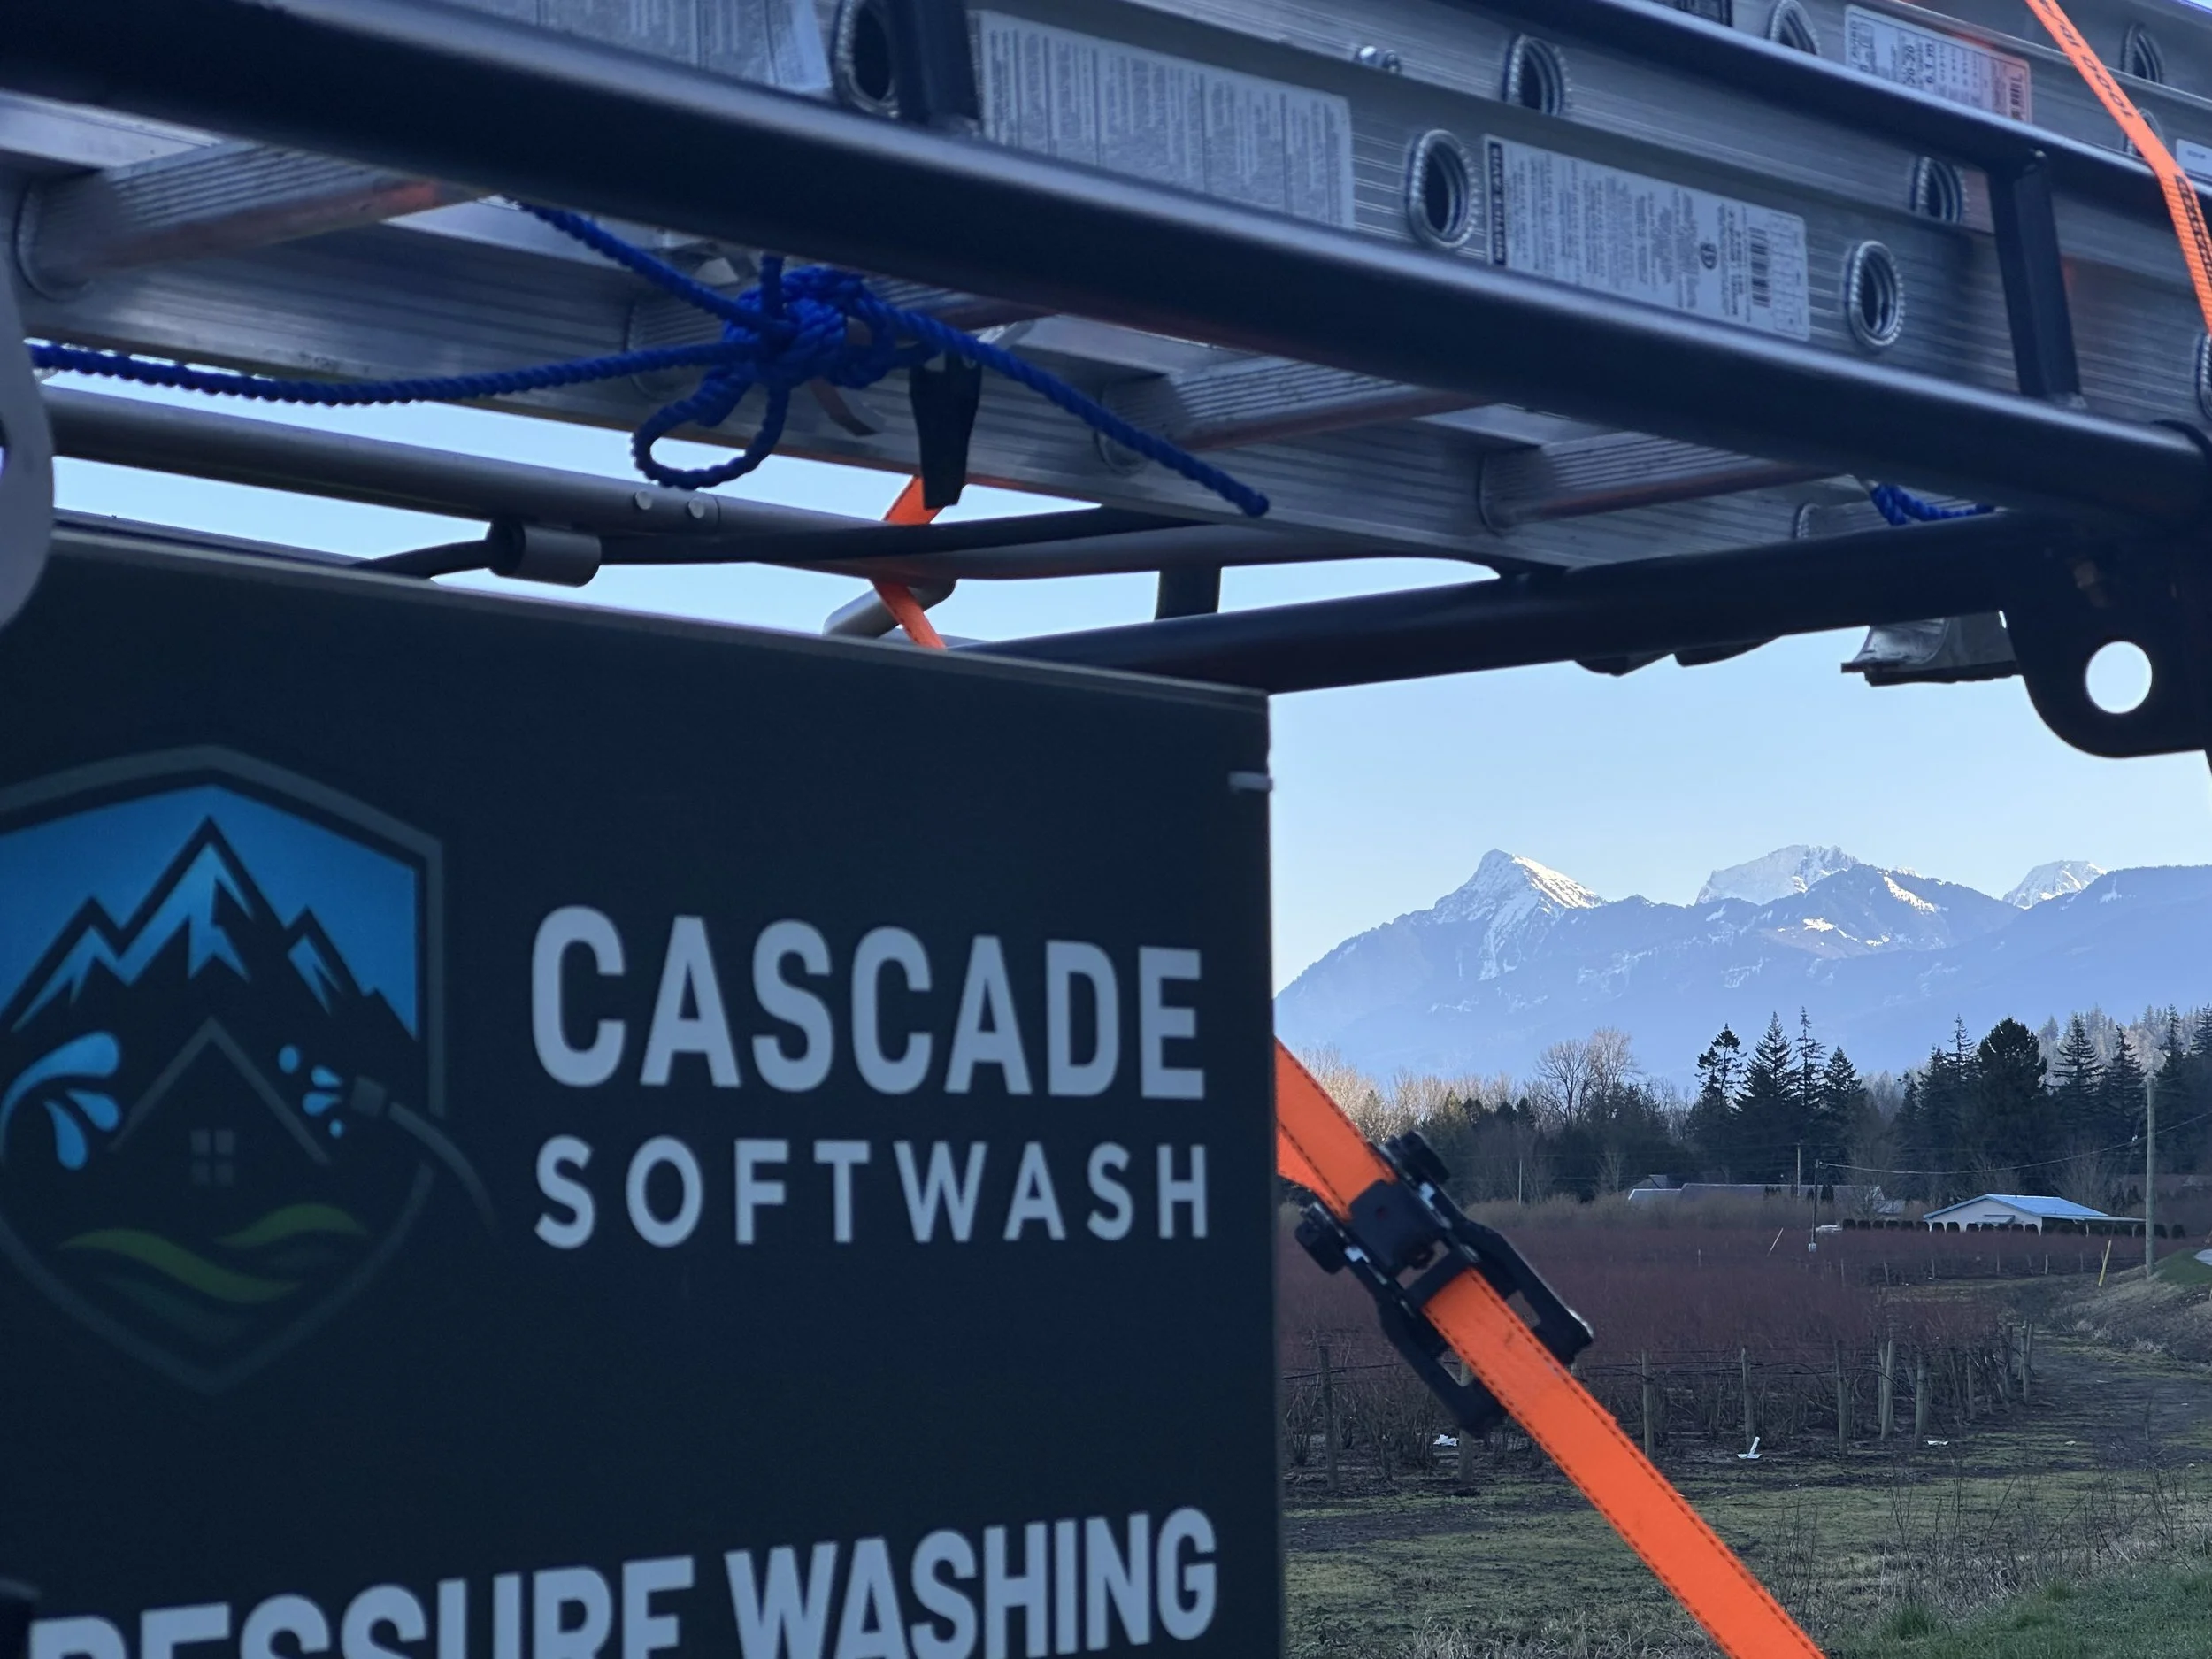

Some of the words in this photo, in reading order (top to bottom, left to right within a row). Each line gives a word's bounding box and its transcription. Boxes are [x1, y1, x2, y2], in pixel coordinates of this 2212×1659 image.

[531, 905, 1205, 1099] CASCADE
[534, 1134, 1208, 1248] SOFTWASH
[724, 1506, 1217, 1659] WASHING
